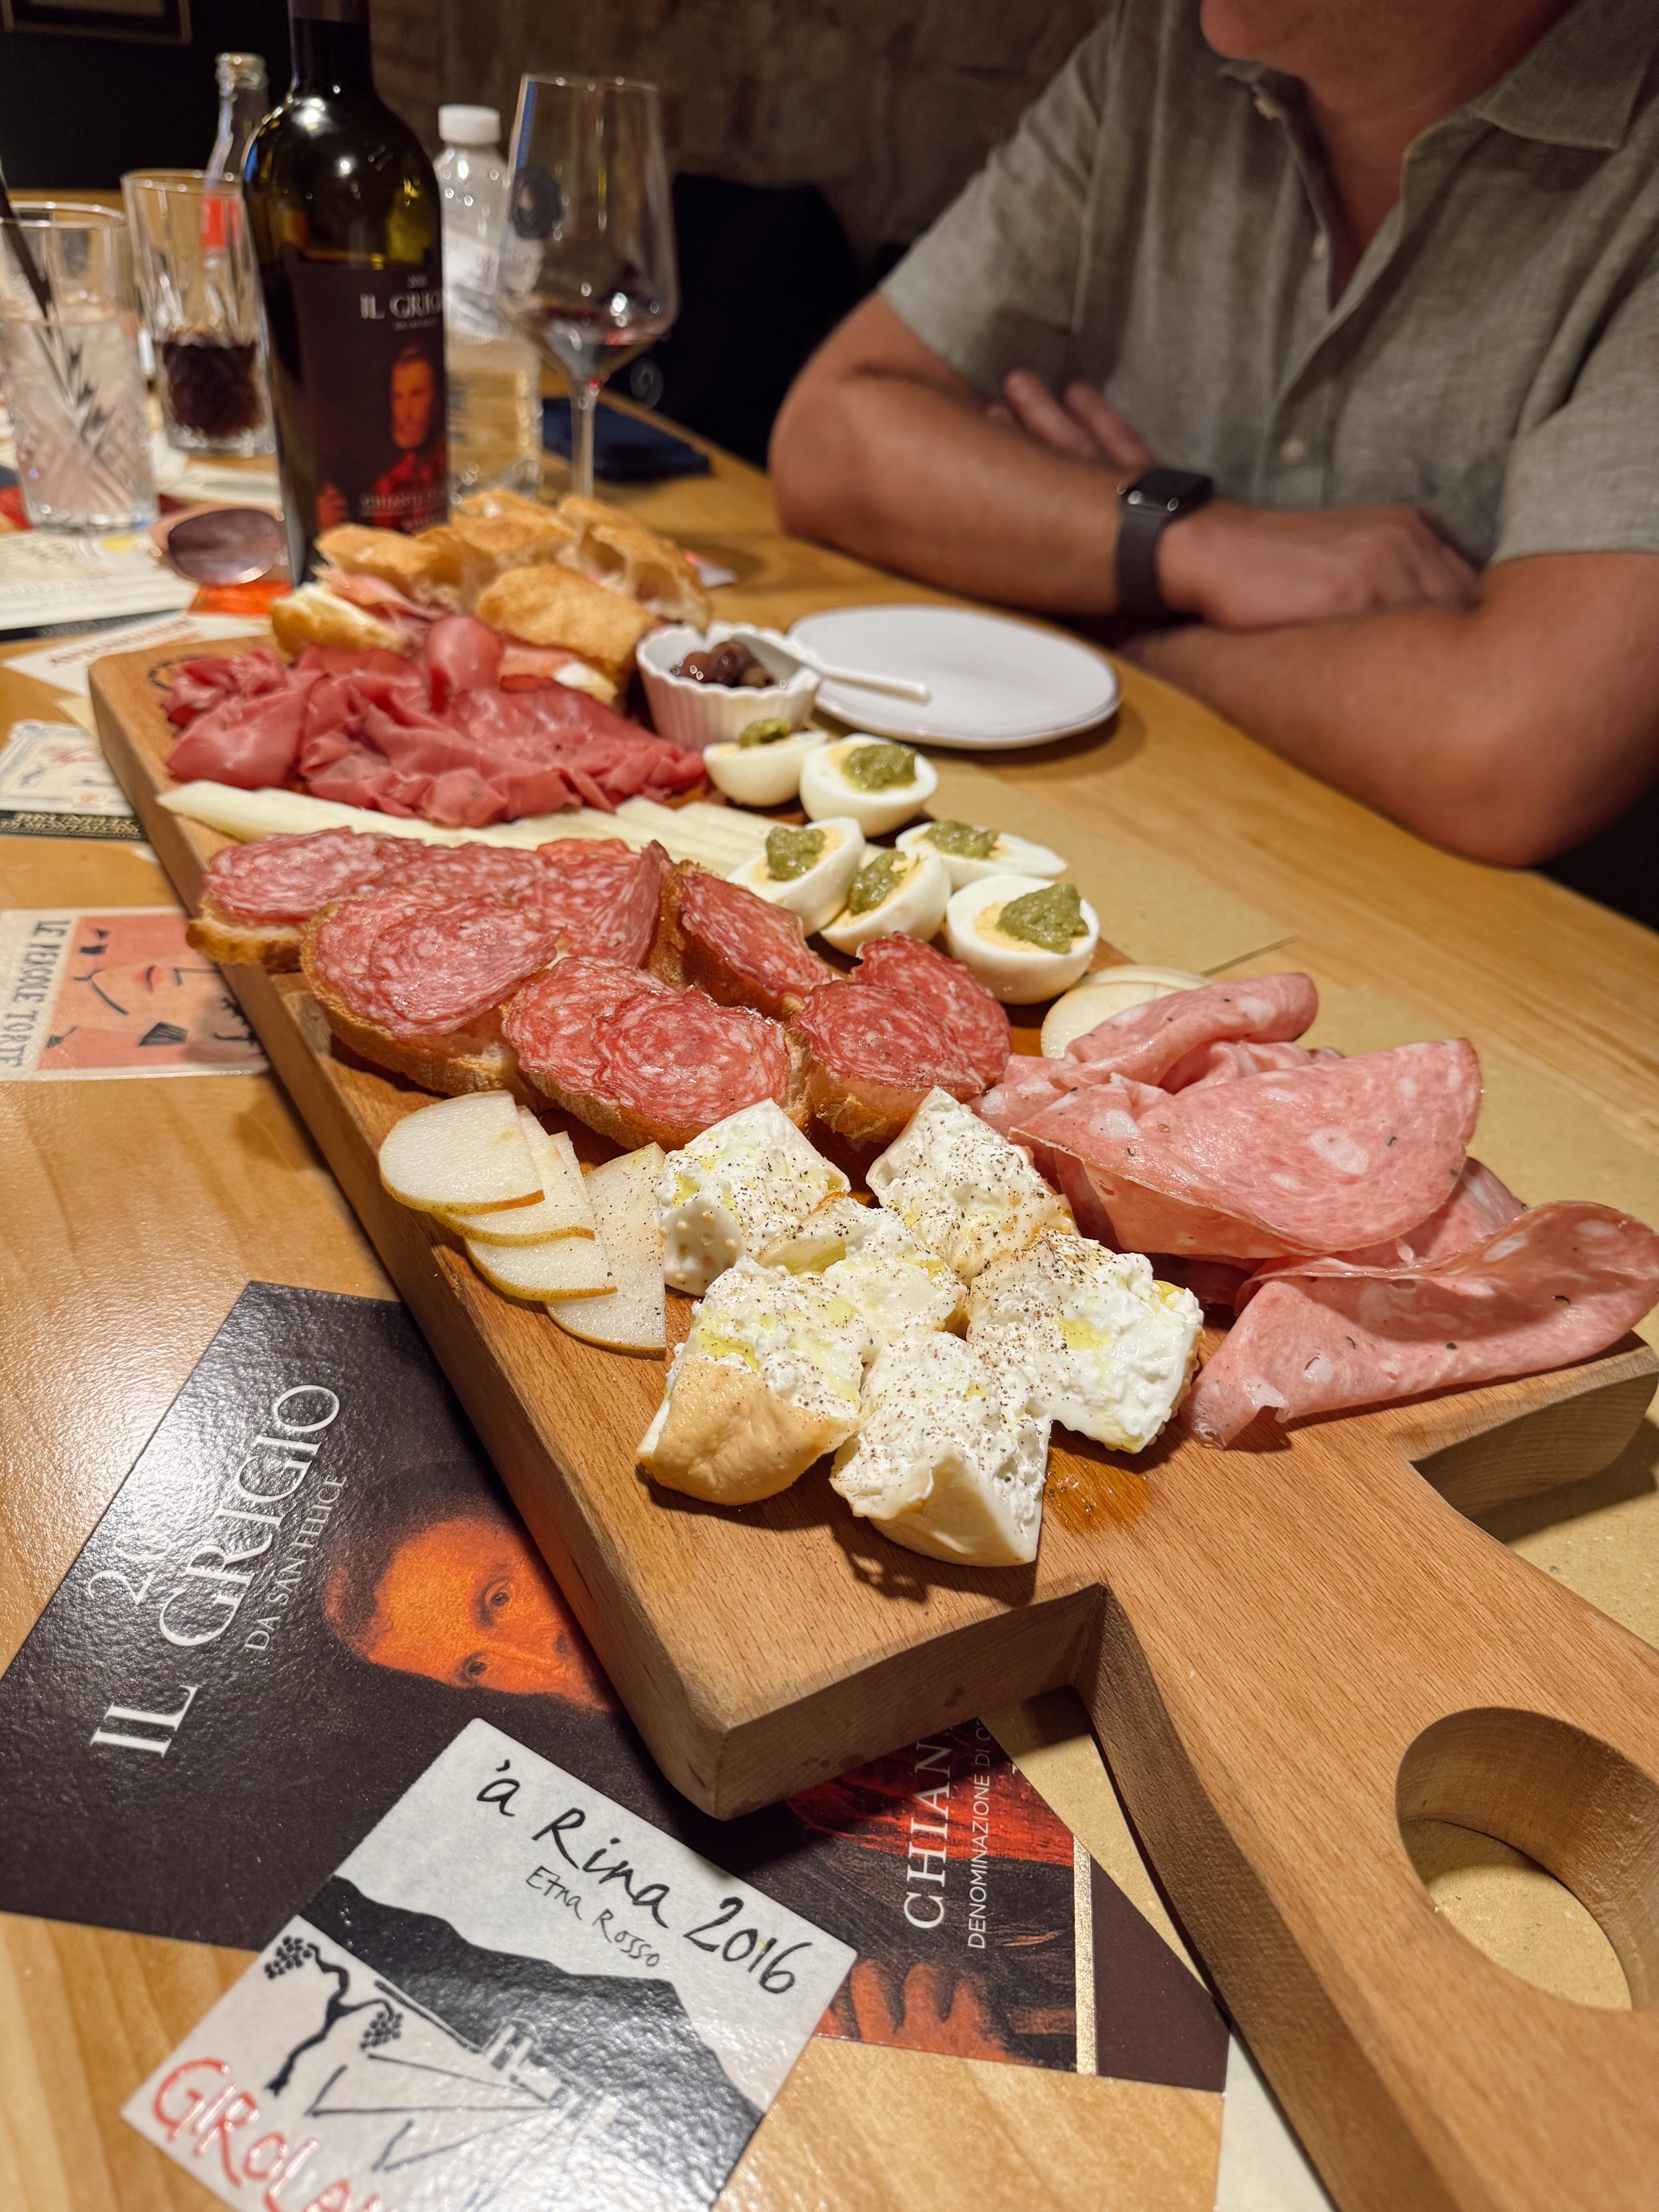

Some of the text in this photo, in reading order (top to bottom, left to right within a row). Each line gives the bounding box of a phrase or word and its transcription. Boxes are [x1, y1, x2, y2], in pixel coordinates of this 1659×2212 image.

[360, 293, 385, 319] IL
[33, 920, 71, 936] LE
[90, 1384, 340, 1757] IL GRIGIO
[244, 1475, 348, 1651] DA SAN FELICE
[904, 1726, 953, 1929] CHIAN
[974, 1748, 990, 1767] DI
[526, 1865, 660, 1968] Etna Rosso
[532, 1807, 669, 1929] Rina
[683, 1896, 813, 1994] 2016
[968, 1773, 990, 1949] DENOMINAZIONE
[151, 2057, 394, 2212] GIROLA
